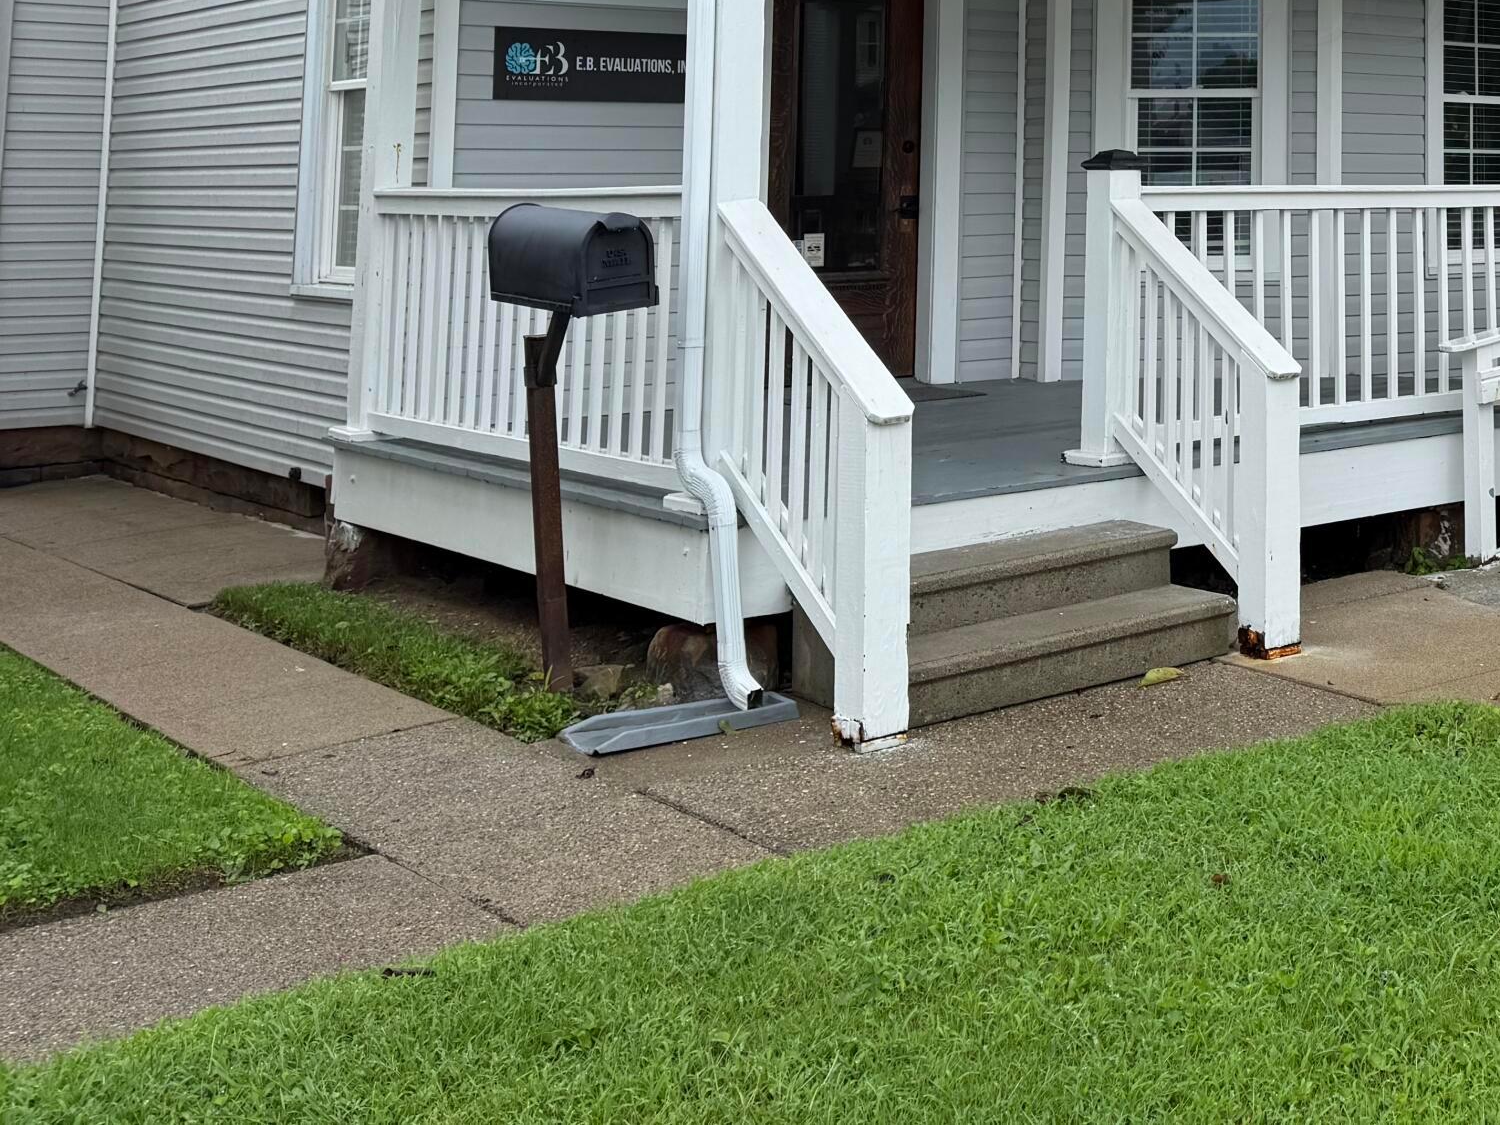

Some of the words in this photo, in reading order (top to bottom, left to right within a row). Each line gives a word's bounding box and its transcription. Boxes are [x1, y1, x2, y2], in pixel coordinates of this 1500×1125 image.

[576, 56, 597, 72] E.B.
[600, 57, 675, 74] EVALUATIONS,
[677, 61, 687, 74] IN
[505, 75, 569, 83] EVALUATIONS
